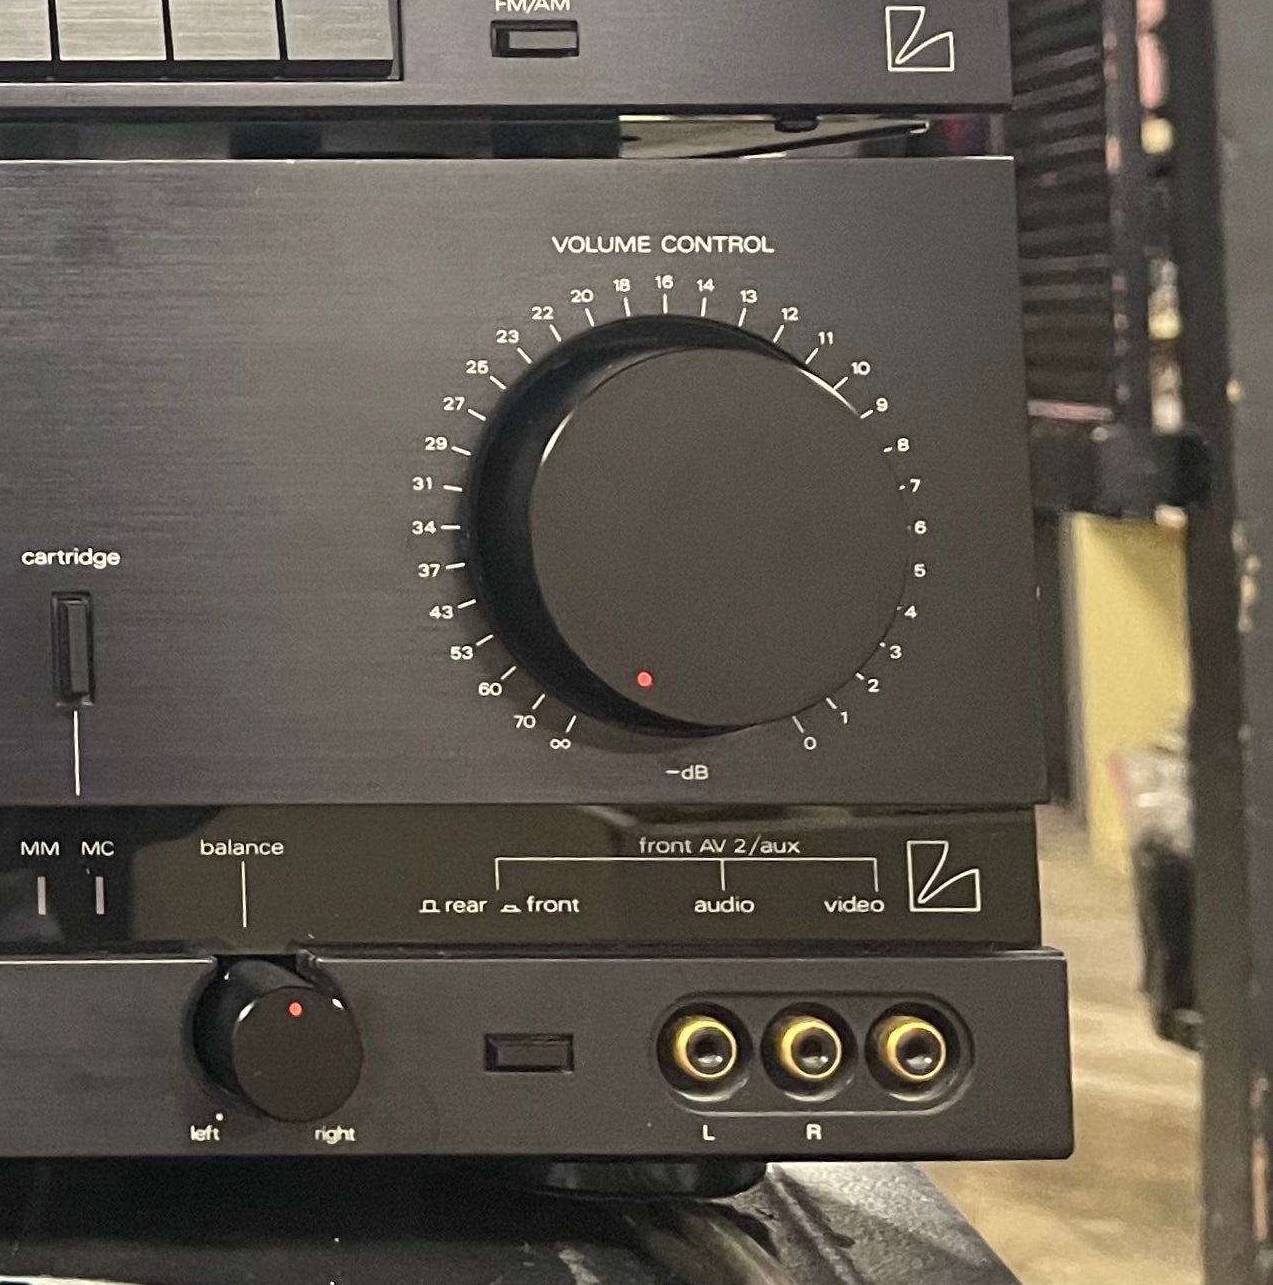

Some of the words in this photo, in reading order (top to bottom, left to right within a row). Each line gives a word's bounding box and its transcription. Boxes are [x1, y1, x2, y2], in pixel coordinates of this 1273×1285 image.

[552, 236, 651, 253] VOLUME
[661, 235, 774, 253] CONTROL
[613, 279, 630, 292] 18
[655, 275, 673, 289] 16
[697, 279, 714, 291] 14
[571, 289, 593, 302] 20
[741, 290, 757, 303] 13
[532, 306, 553, 319] 22
[781, 307, 798, 321] 12
[496, 330, 519, 343] 23
[819, 332, 833, 344] 11
[466, 360, 488, 374] 25
[852, 362, 870, 375] 10
[444, 397, 464, 410] 27
[876, 398, 888, 411] 9
[425, 437, 447, 450] 29
[898, 438, 909, 451] 8
[413, 477, 432, 490] 31
[910, 479, 920, 492] 7
[412, 521, 436, 534] 34
[915, 521, 926, 534] 6
[22, 548, 120, 569] cartridge
[419, 564, 440, 577] 37
[914, 564, 925, 577] 5
[429, 605, 453, 619] 43
[905, 606, 916, 618] 4
[451, 646, 473, 660] 53
[890, 646, 901, 659] 3
[479, 682, 502, 696] 60
[868, 679, 879, 692] 2
[514, 715, 536, 728] 70
[841, 712, 847, 723] 1
[804, 737, 816, 750] 0
[21, 842, 59, 855] MM
[82, 841, 114, 856] MC
[201, 839, 283, 855] balance
[640, 837, 691, 853] front
[700, 839, 726, 852] AV
[446, 900, 487, 913] rear
[527, 896, 579, 912] front
[695, 896, 754, 912] audio
[824, 896, 884, 912] video
[191, 1125, 219, 1141] left
[315, 1126, 355, 1144] right
[703, 1125, 715, 1140] L
[807, 1124, 821, 1139] R
